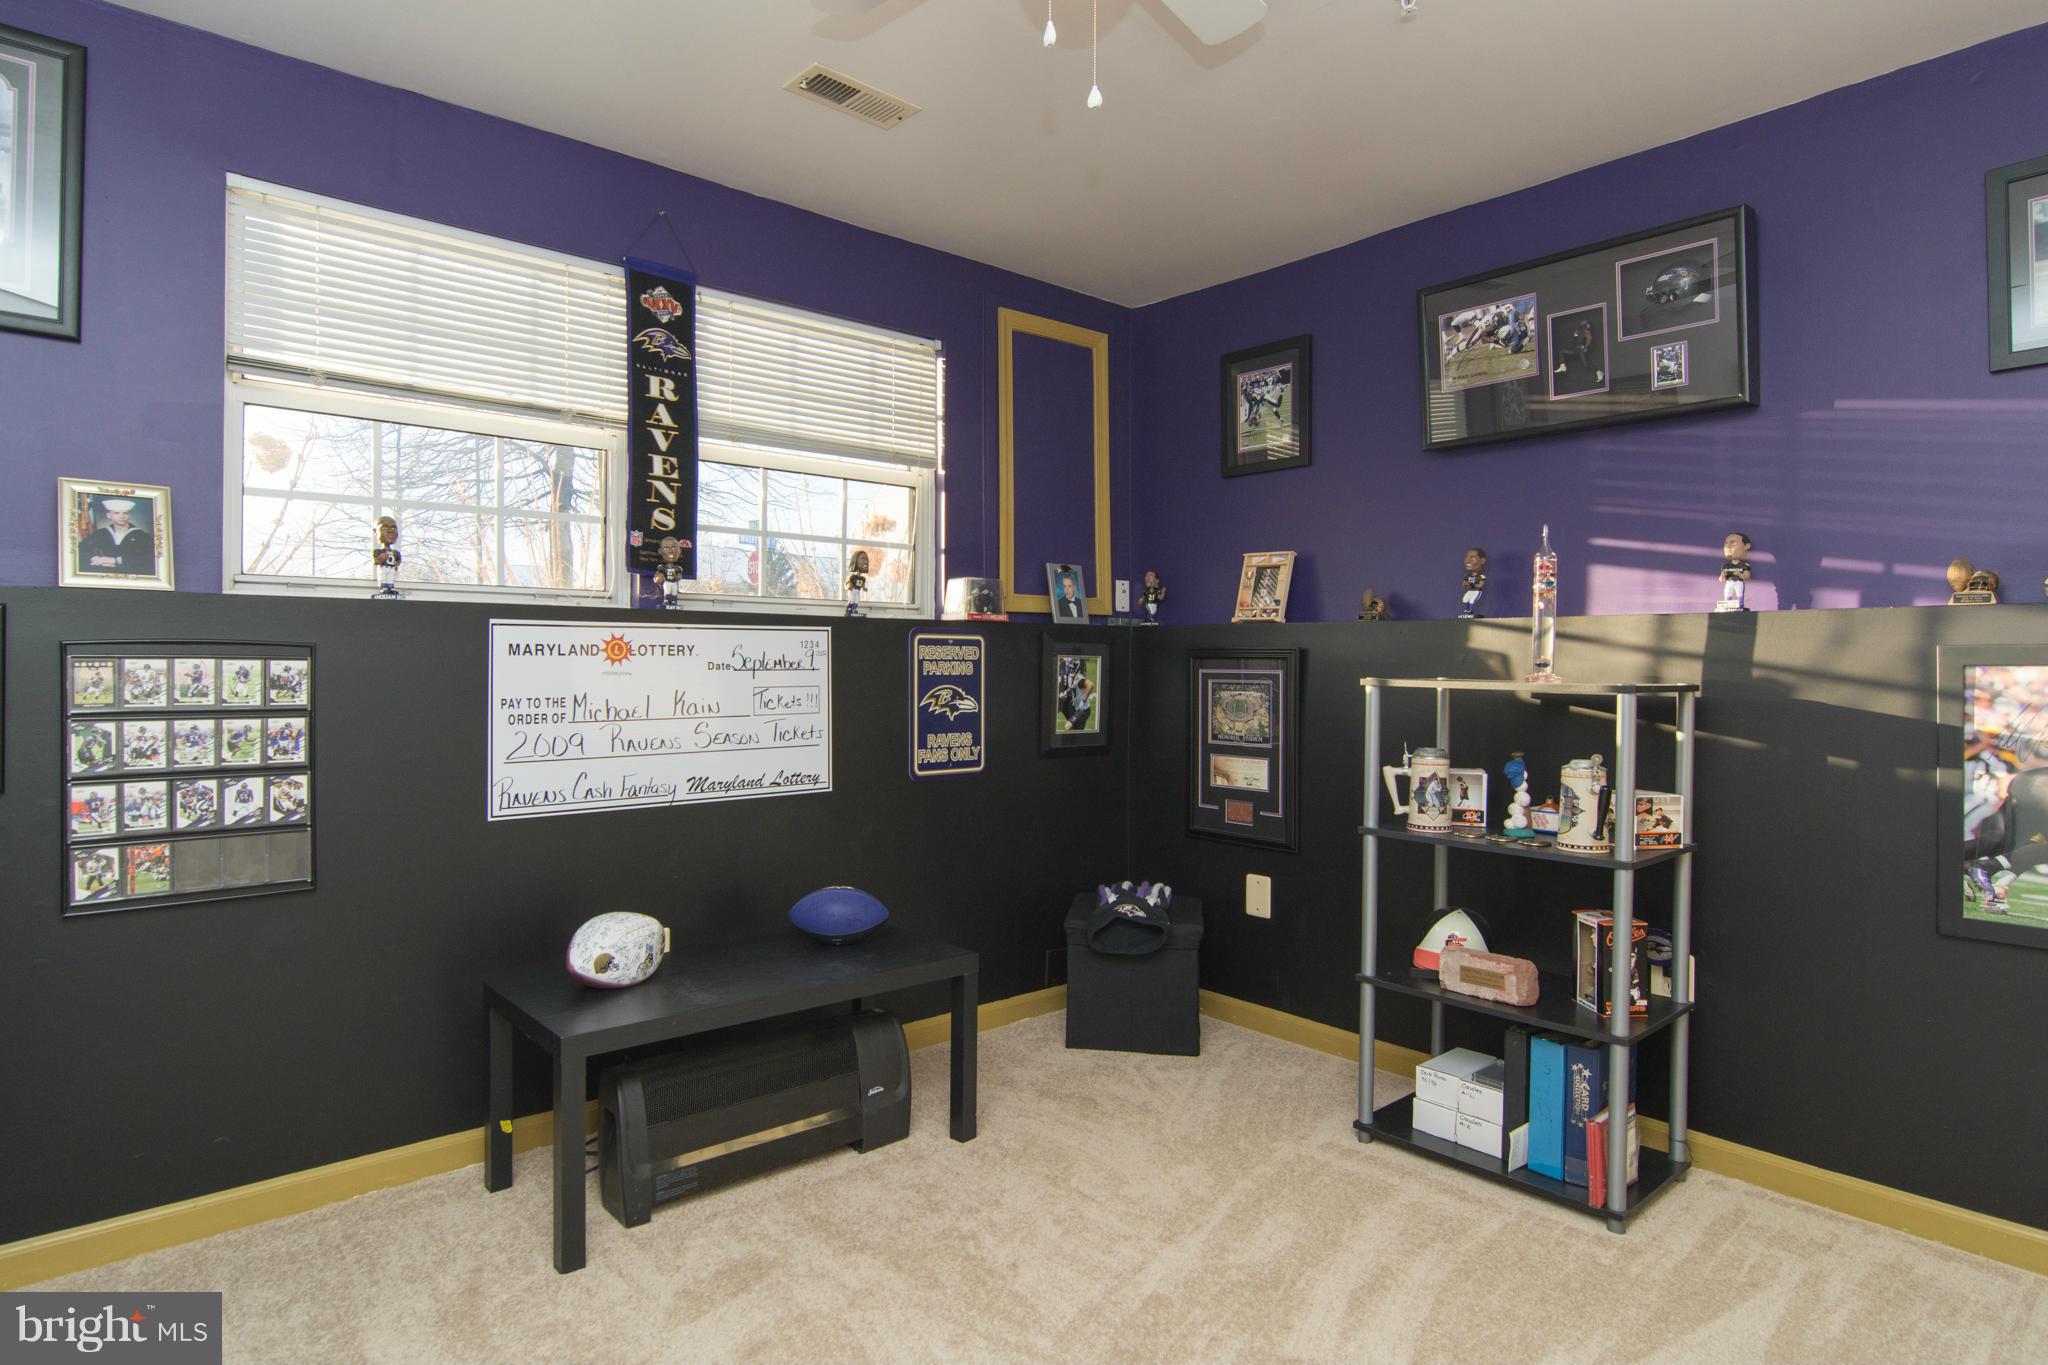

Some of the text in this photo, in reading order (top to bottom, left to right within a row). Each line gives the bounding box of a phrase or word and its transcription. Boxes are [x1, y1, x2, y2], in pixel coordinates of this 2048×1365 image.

[644, 374, 682, 531] RAVENS
[508, 643, 600, 657] MARYLAND
[800, 640, 820, 649] 1234
[918, 644, 980, 661] RESERVED
[707, 661, 731, 671] Date
[922, 661, 974, 676] PARKING
[500, 697, 566, 709] PAY TO THE
[507, 713, 566, 725] ORDER OF
[506, 730, 585, 760] 2009
[927, 731, 973, 749] RAVENS
[917, 746, 981, 764] FANS ONLY
[686, 769, 821, 794] Maryland Lottery
[1581, 1082, 1591, 1112] CARD
